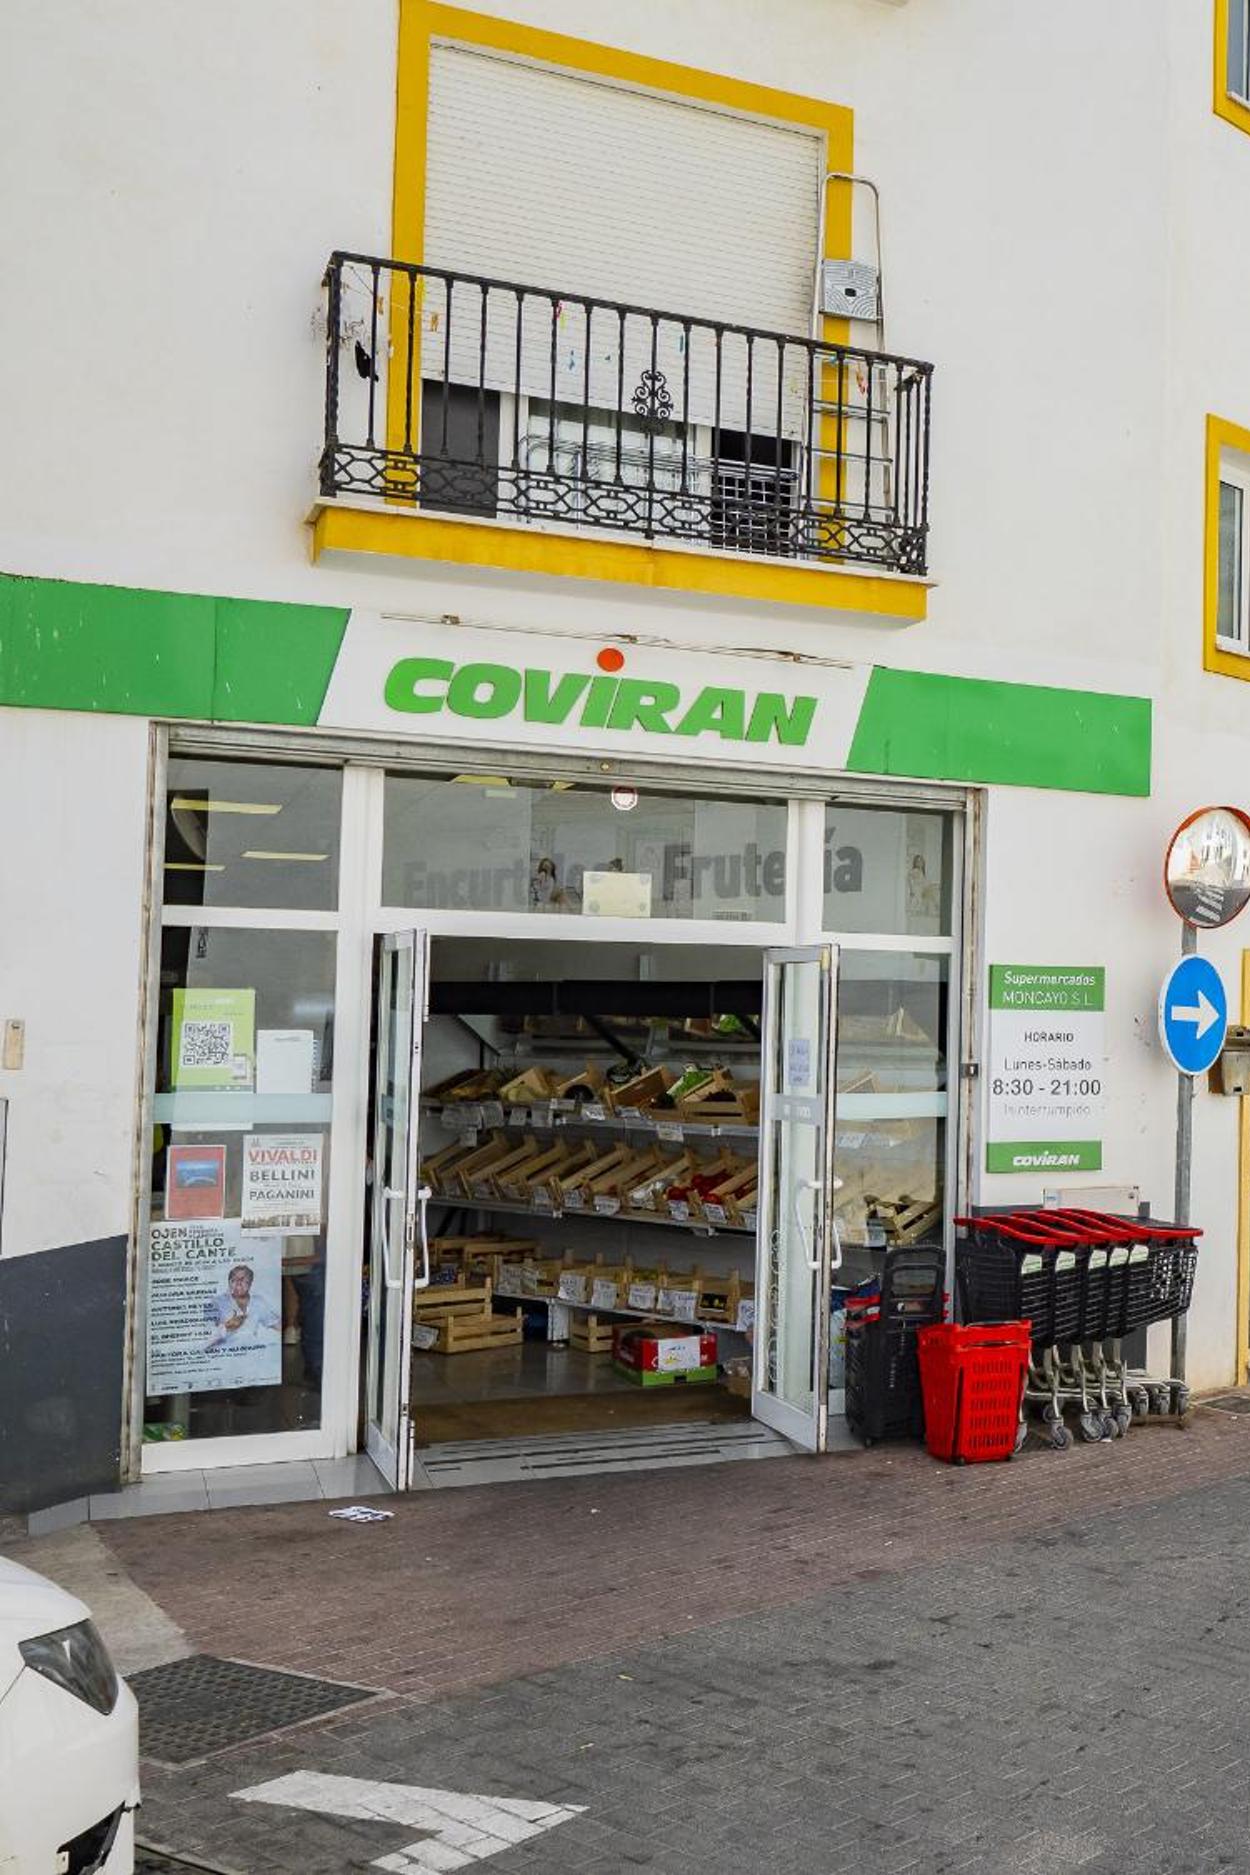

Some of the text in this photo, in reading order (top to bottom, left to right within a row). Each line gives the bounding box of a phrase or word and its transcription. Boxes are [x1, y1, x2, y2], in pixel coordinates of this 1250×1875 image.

[1003, 990, 1068, 1005] MONCAYO
[1024, 1031, 1075, 1043] HORARIO
[992, 1078, 1034, 1096] 8:30
[1050, 1079, 1101, 1096] 21:00
[249, 1149, 317, 1163] VIVALDI
[249, 1168, 315, 1182] BELLINI
[249, 1188, 315, 1201] PAGANINI
[151, 1237, 224, 1251] CASTILLO
[151, 1246, 237, 1262] DEL CANTE
